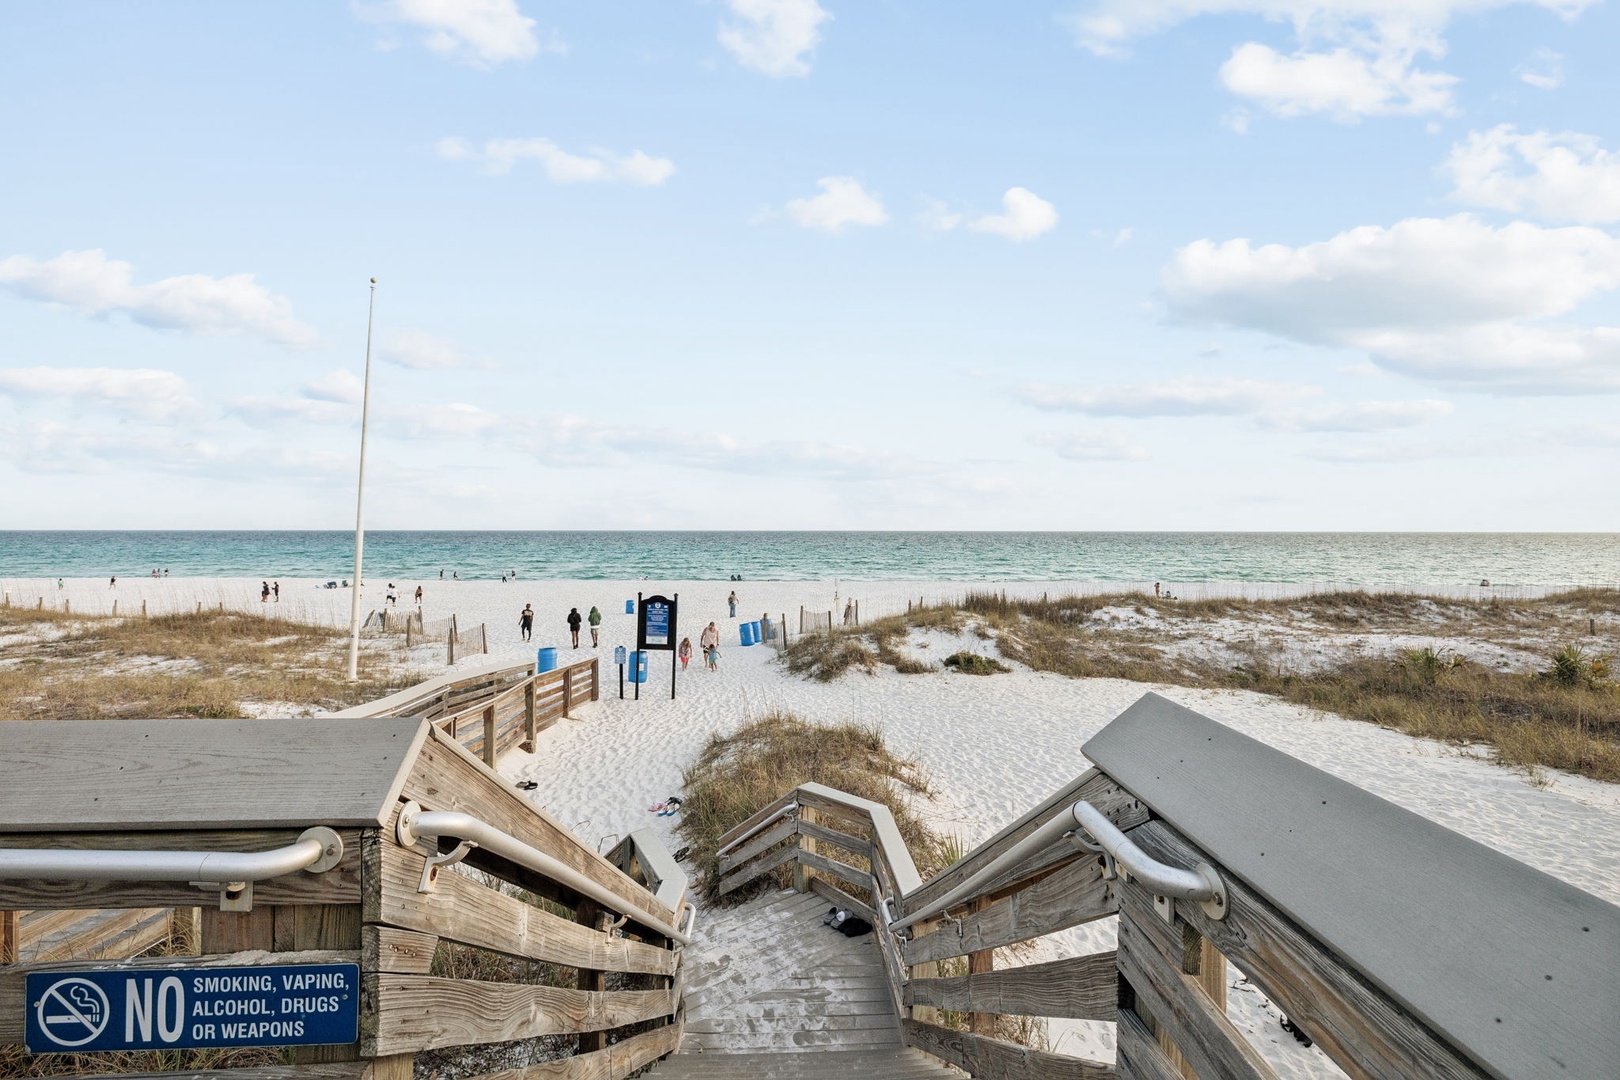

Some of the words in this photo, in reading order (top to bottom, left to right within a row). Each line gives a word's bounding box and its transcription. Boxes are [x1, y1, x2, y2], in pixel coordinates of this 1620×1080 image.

[193, 976, 278, 994] SMOKING,
[282, 973, 350, 991] VAPING,
[125, 976, 185, 1043] NO
[192, 998, 275, 1017] ALCOHOL,
[281, 997, 339, 1015] DRUGS
[192, 1024, 216, 1041] OR
[221, 1021, 304, 1039] WEAPONS
